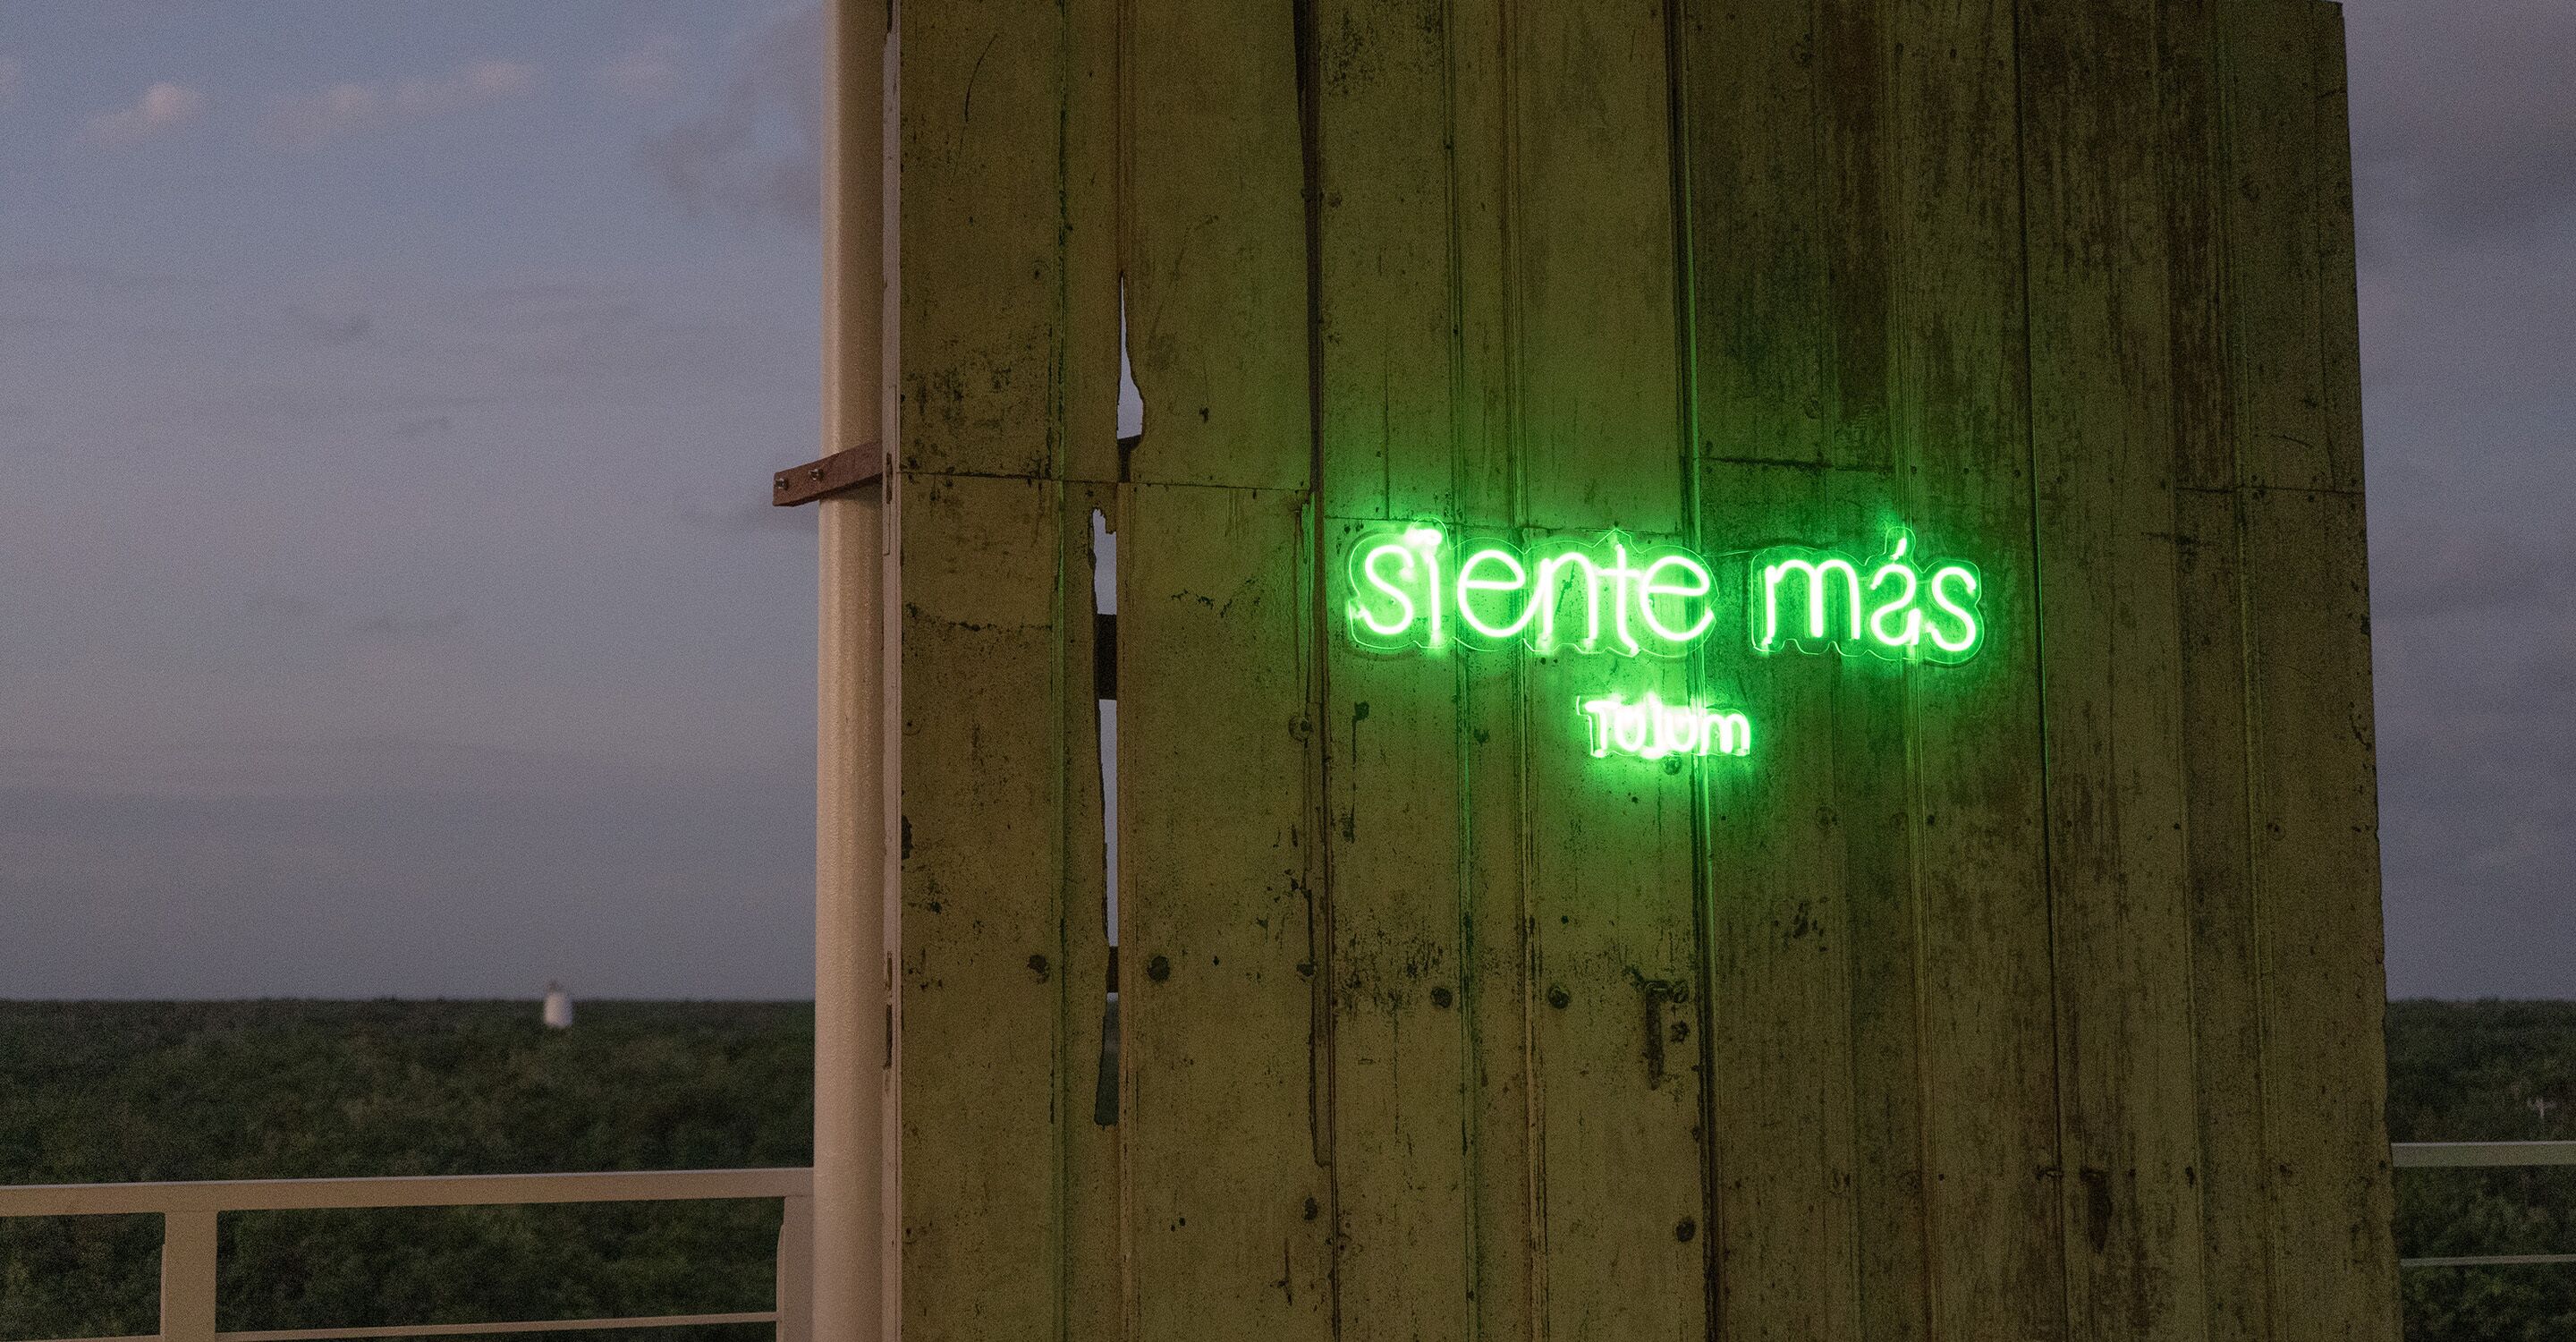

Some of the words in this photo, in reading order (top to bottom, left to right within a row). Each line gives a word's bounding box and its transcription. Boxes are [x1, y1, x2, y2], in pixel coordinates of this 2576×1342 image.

[1354, 527, 1716, 656] siente
[1761, 537, 1979, 652] más
[1582, 692, 1751, 760] Tulum
